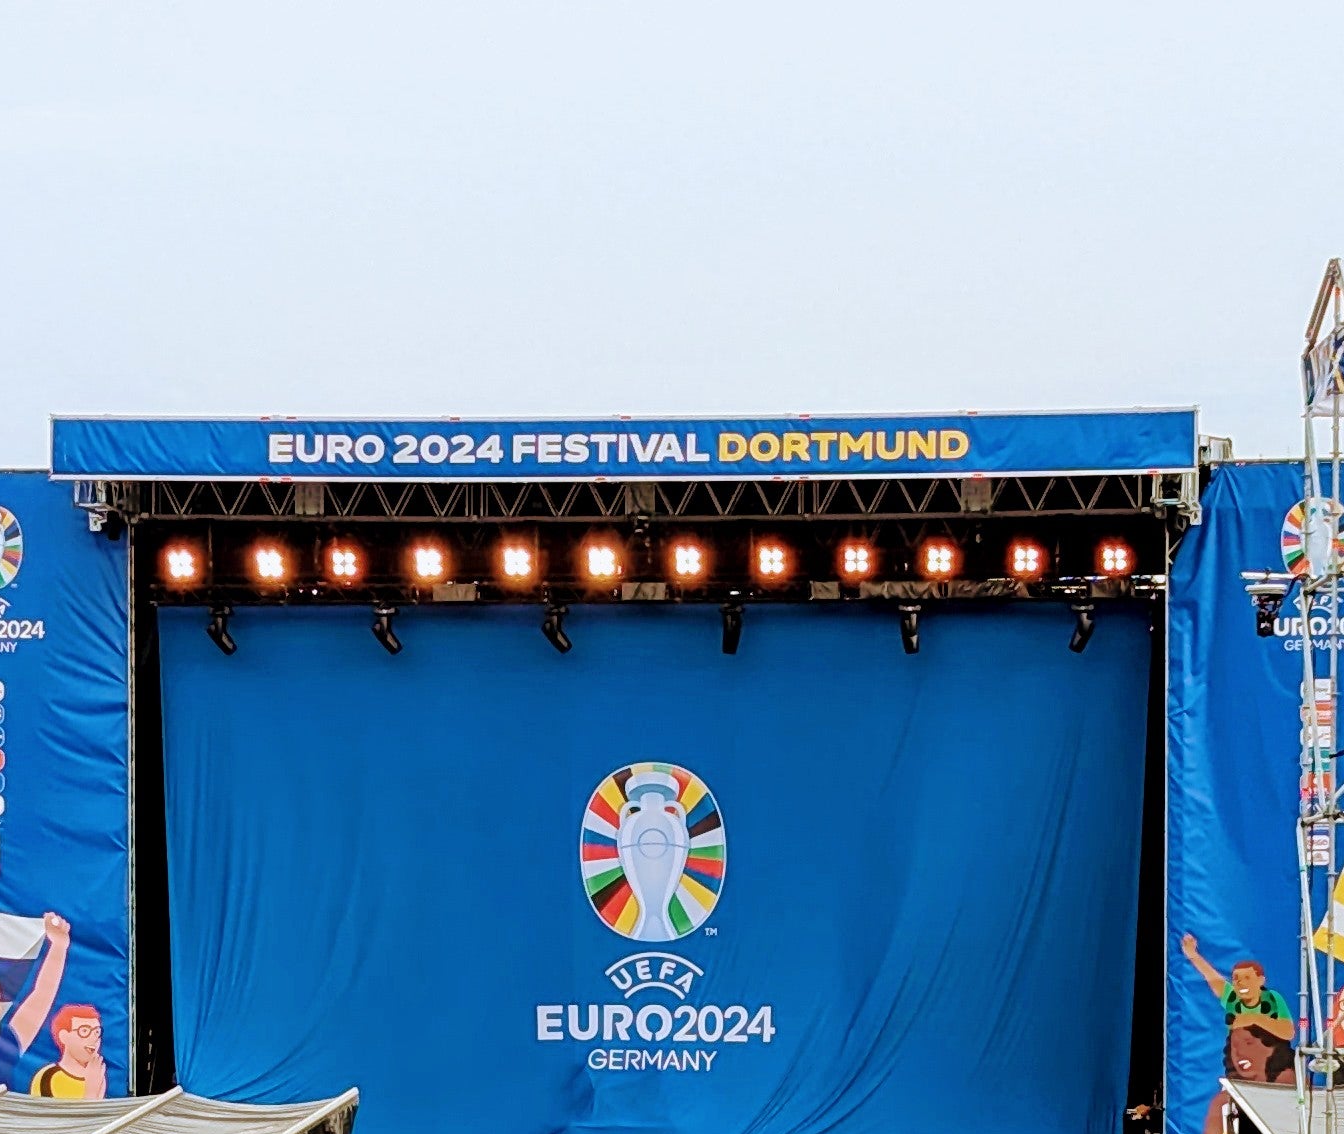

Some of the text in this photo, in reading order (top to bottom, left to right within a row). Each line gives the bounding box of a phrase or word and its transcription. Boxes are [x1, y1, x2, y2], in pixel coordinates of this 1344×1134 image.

[267, 430, 970, 465] EURO 2024 FESTIVAL DORTMUND
[610, 959, 694, 994] UEFA
[536, 1004, 776, 1043] EURO2024
[587, 1049, 718, 1072] GERMANY
